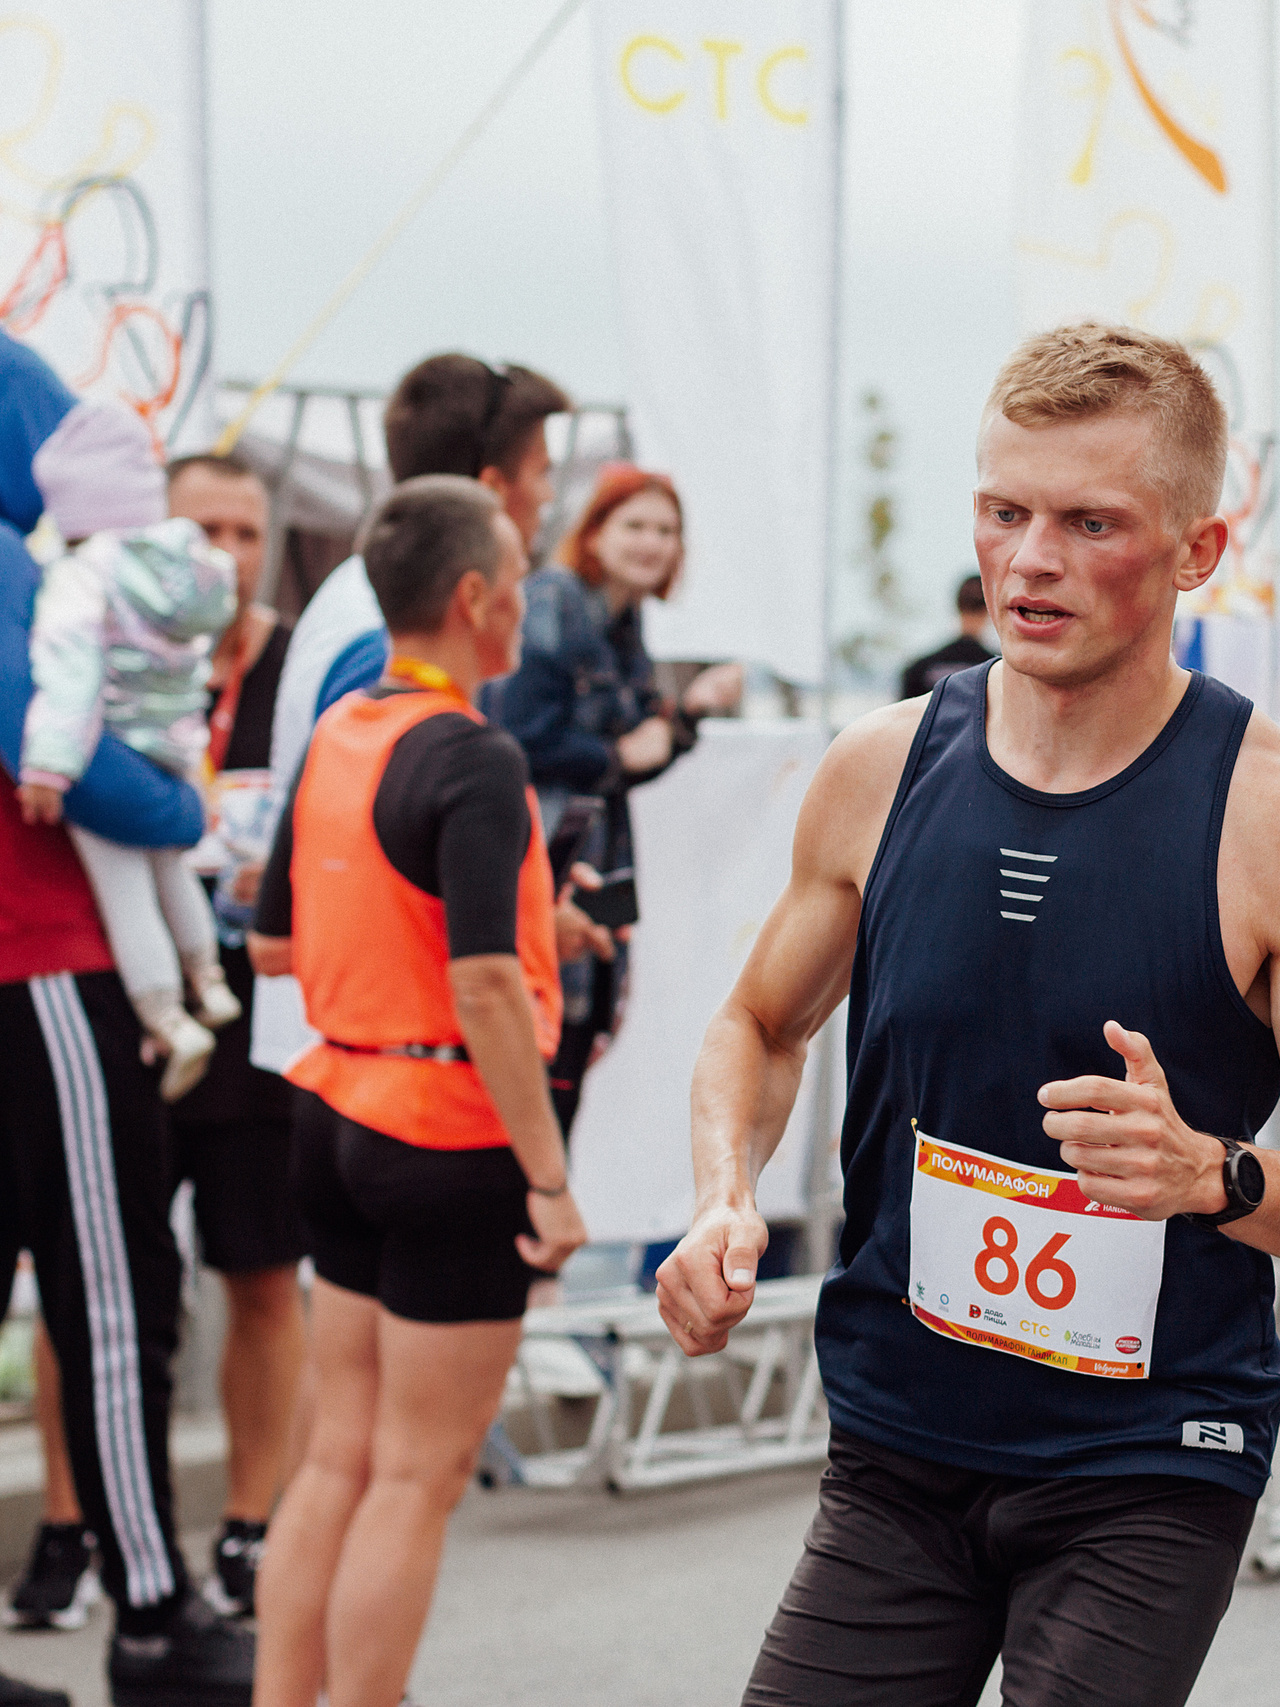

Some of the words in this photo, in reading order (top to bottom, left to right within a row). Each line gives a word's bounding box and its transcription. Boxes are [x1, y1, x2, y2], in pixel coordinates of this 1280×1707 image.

[931, 1153, 1050, 1198] ПОЛУМАРАФОН
[974, 1215, 1077, 1310] 86
[983, 1315, 1008, 1327] ПИЦЦА
[966, 1330, 1026, 1353] ПОЛУМАРАФОН
[1027, 1347, 1068, 1365] ГАНДИКАП
[1094, 1362, 1129, 1375] Volgograd
